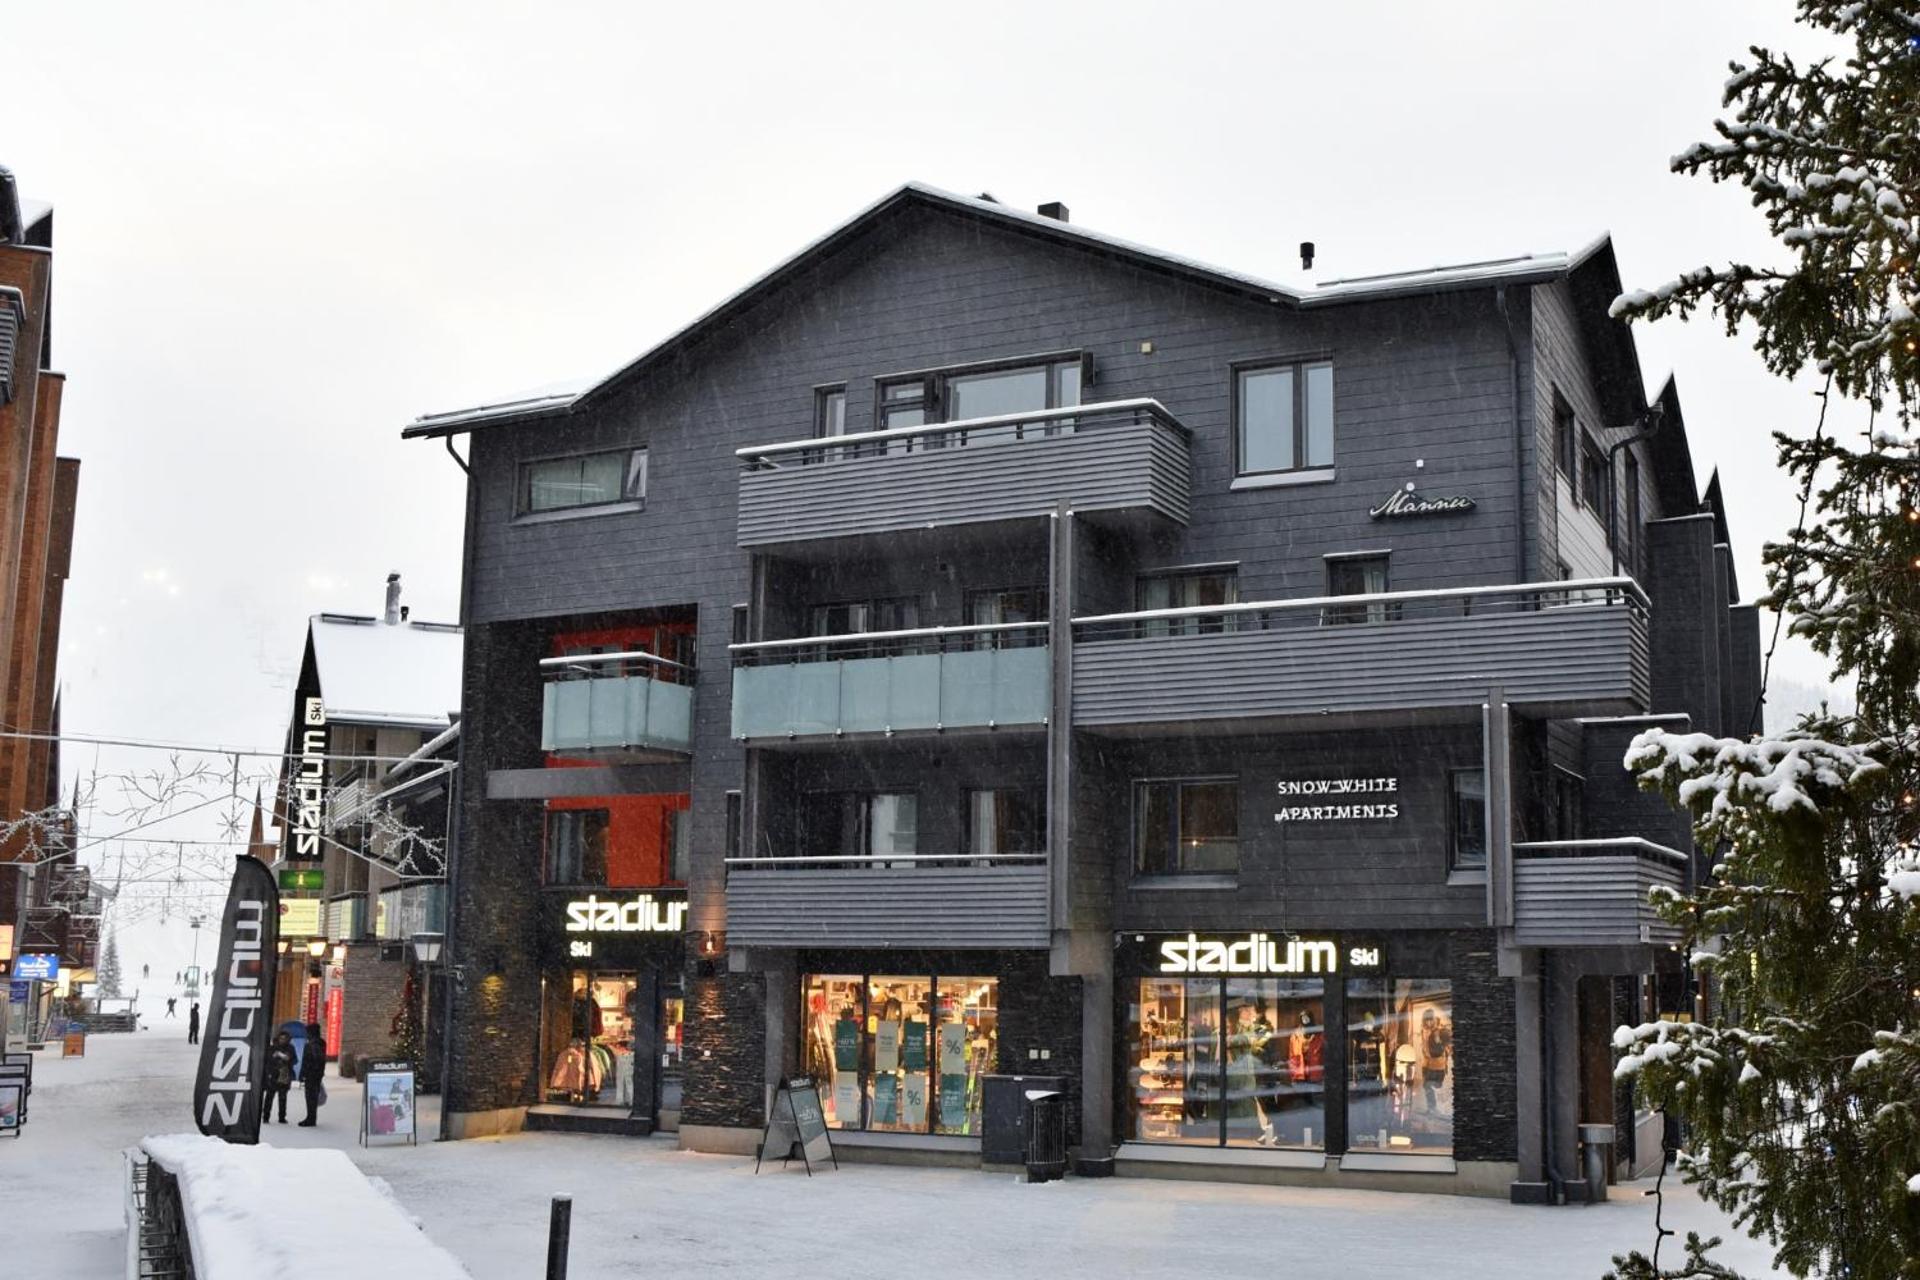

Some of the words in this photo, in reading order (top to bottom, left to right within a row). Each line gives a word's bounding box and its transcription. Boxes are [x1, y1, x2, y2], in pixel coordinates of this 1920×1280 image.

[292, 730, 326, 856] stadium
[311, 702, 322, 721] Ski
[1278, 780, 1330, 794] SNOW
[1339, 778, 1397, 793] WHITE
[1280, 804, 1398, 820] APARTMENTS
[570, 941, 592, 956] Ski
[1160, 933, 1337, 973] stadium
[1349, 948, 1378, 966] Ski
[374, 1062, 407, 1070] stadium
